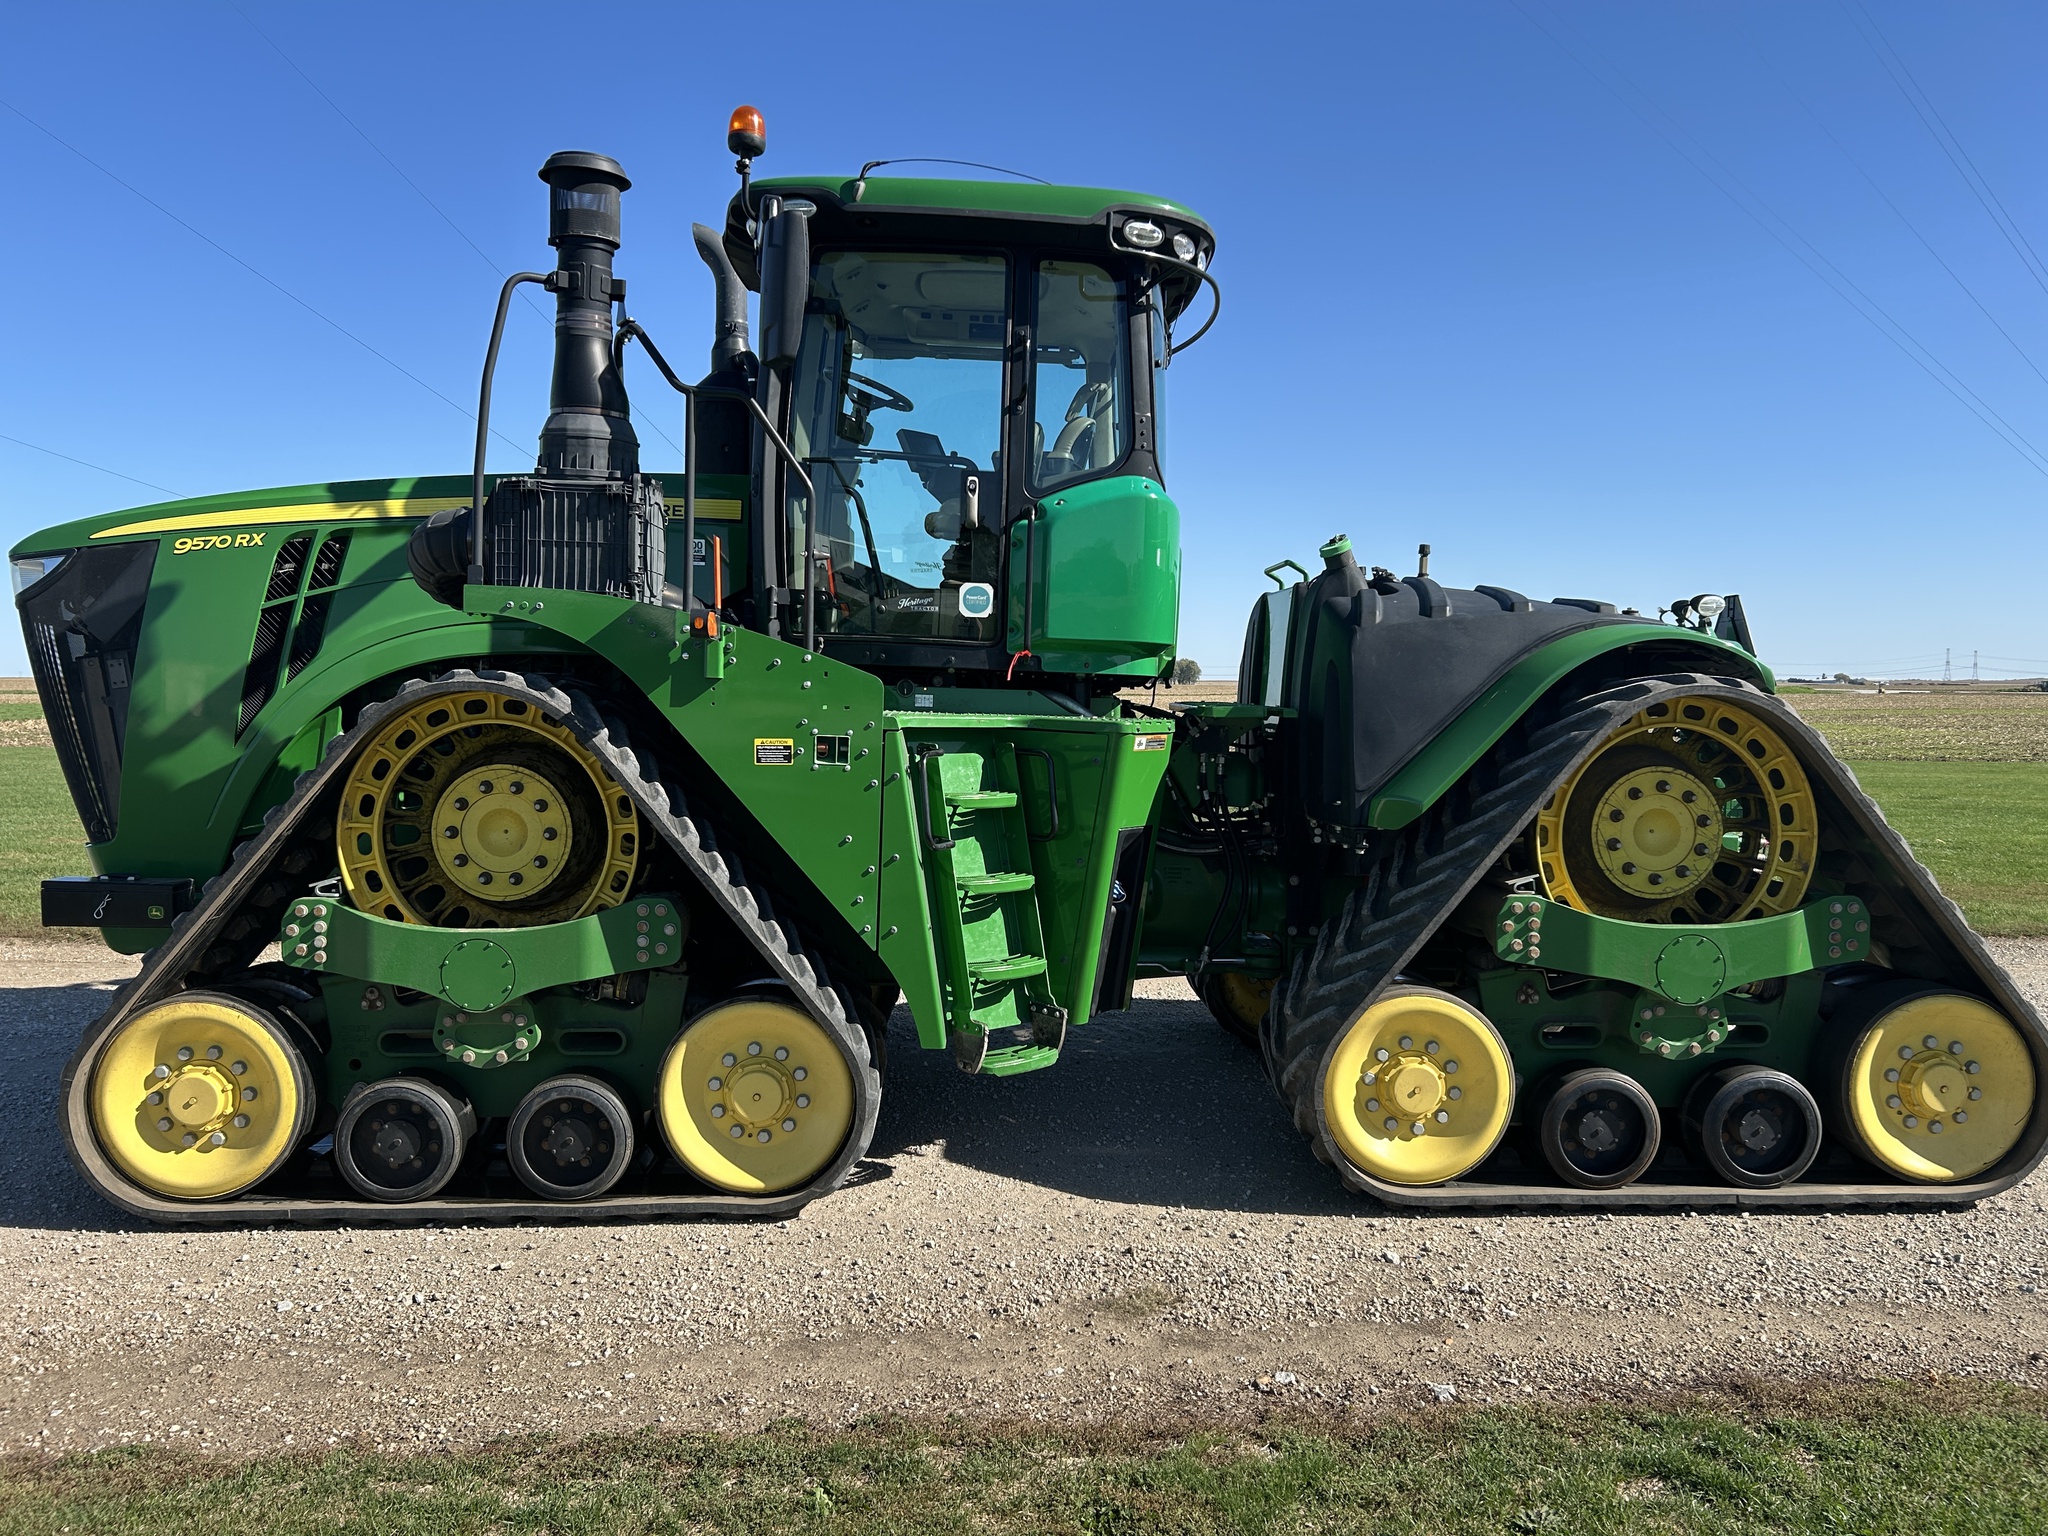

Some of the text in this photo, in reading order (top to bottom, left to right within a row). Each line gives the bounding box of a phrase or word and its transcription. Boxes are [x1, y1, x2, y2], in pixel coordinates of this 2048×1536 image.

[173, 532, 268, 555] 9570 RX
[897, 597, 934, 610] Heritage
